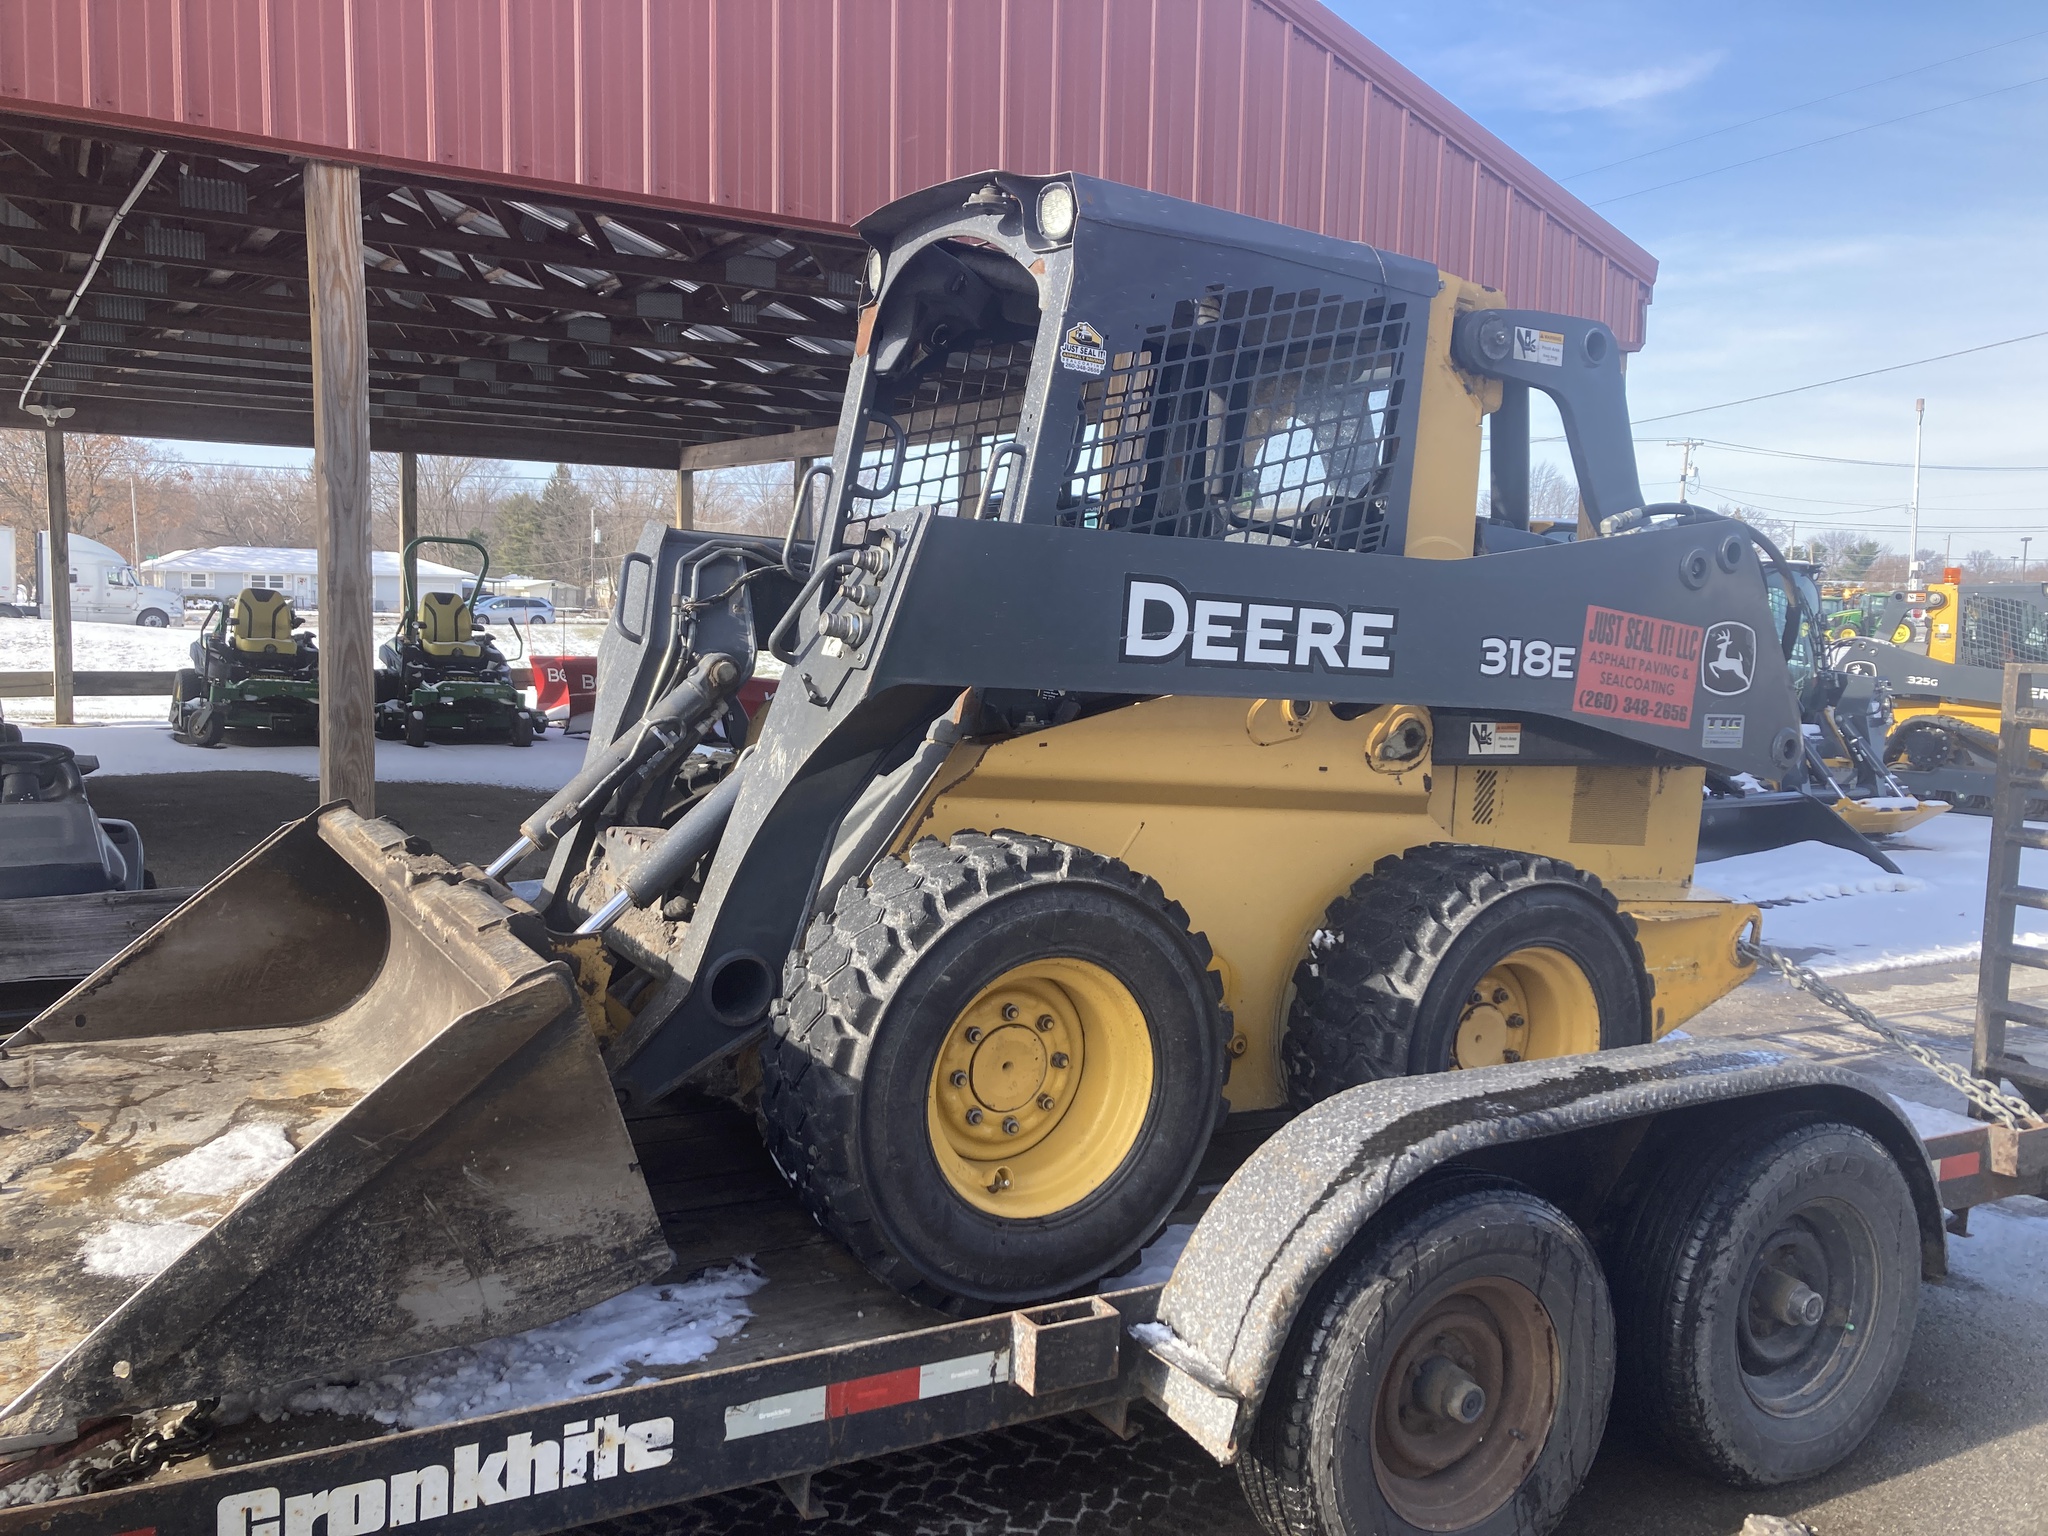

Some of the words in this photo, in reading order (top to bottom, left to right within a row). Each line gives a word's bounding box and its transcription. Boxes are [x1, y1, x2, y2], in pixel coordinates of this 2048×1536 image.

[1062, 344, 1078, 353] JUST
[1080, 347, 1096, 356] SEAL
[1098, 351, 1106, 359] IT!
[1062, 357, 1104, 370] SEALCOATING
[1124, 580, 1395, 671] DEERE
[1588, 610, 1625, 647] JUST
[1624, 617, 1655, 653] SEAL
[1657, 623, 1676, 657] IT!
[1675, 627, 1699, 662] LLC
[1480, 637, 1576, 679] 318E
[1588, 650, 1638, 671] ASPHALT
[1638, 658, 1680, 678] PAVING
[1681, 667, 1689, 680] &
[1599, 671, 1676, 696] SEALCOATING
[1905, 675, 1939, 687] 325G
[1578, 689, 1619, 714] (260)
[1622, 696, 1689, 722] 348-2656
[1706, 716, 1743, 730] TTG
[216, 1413, 675, 1536] Cronkhite
